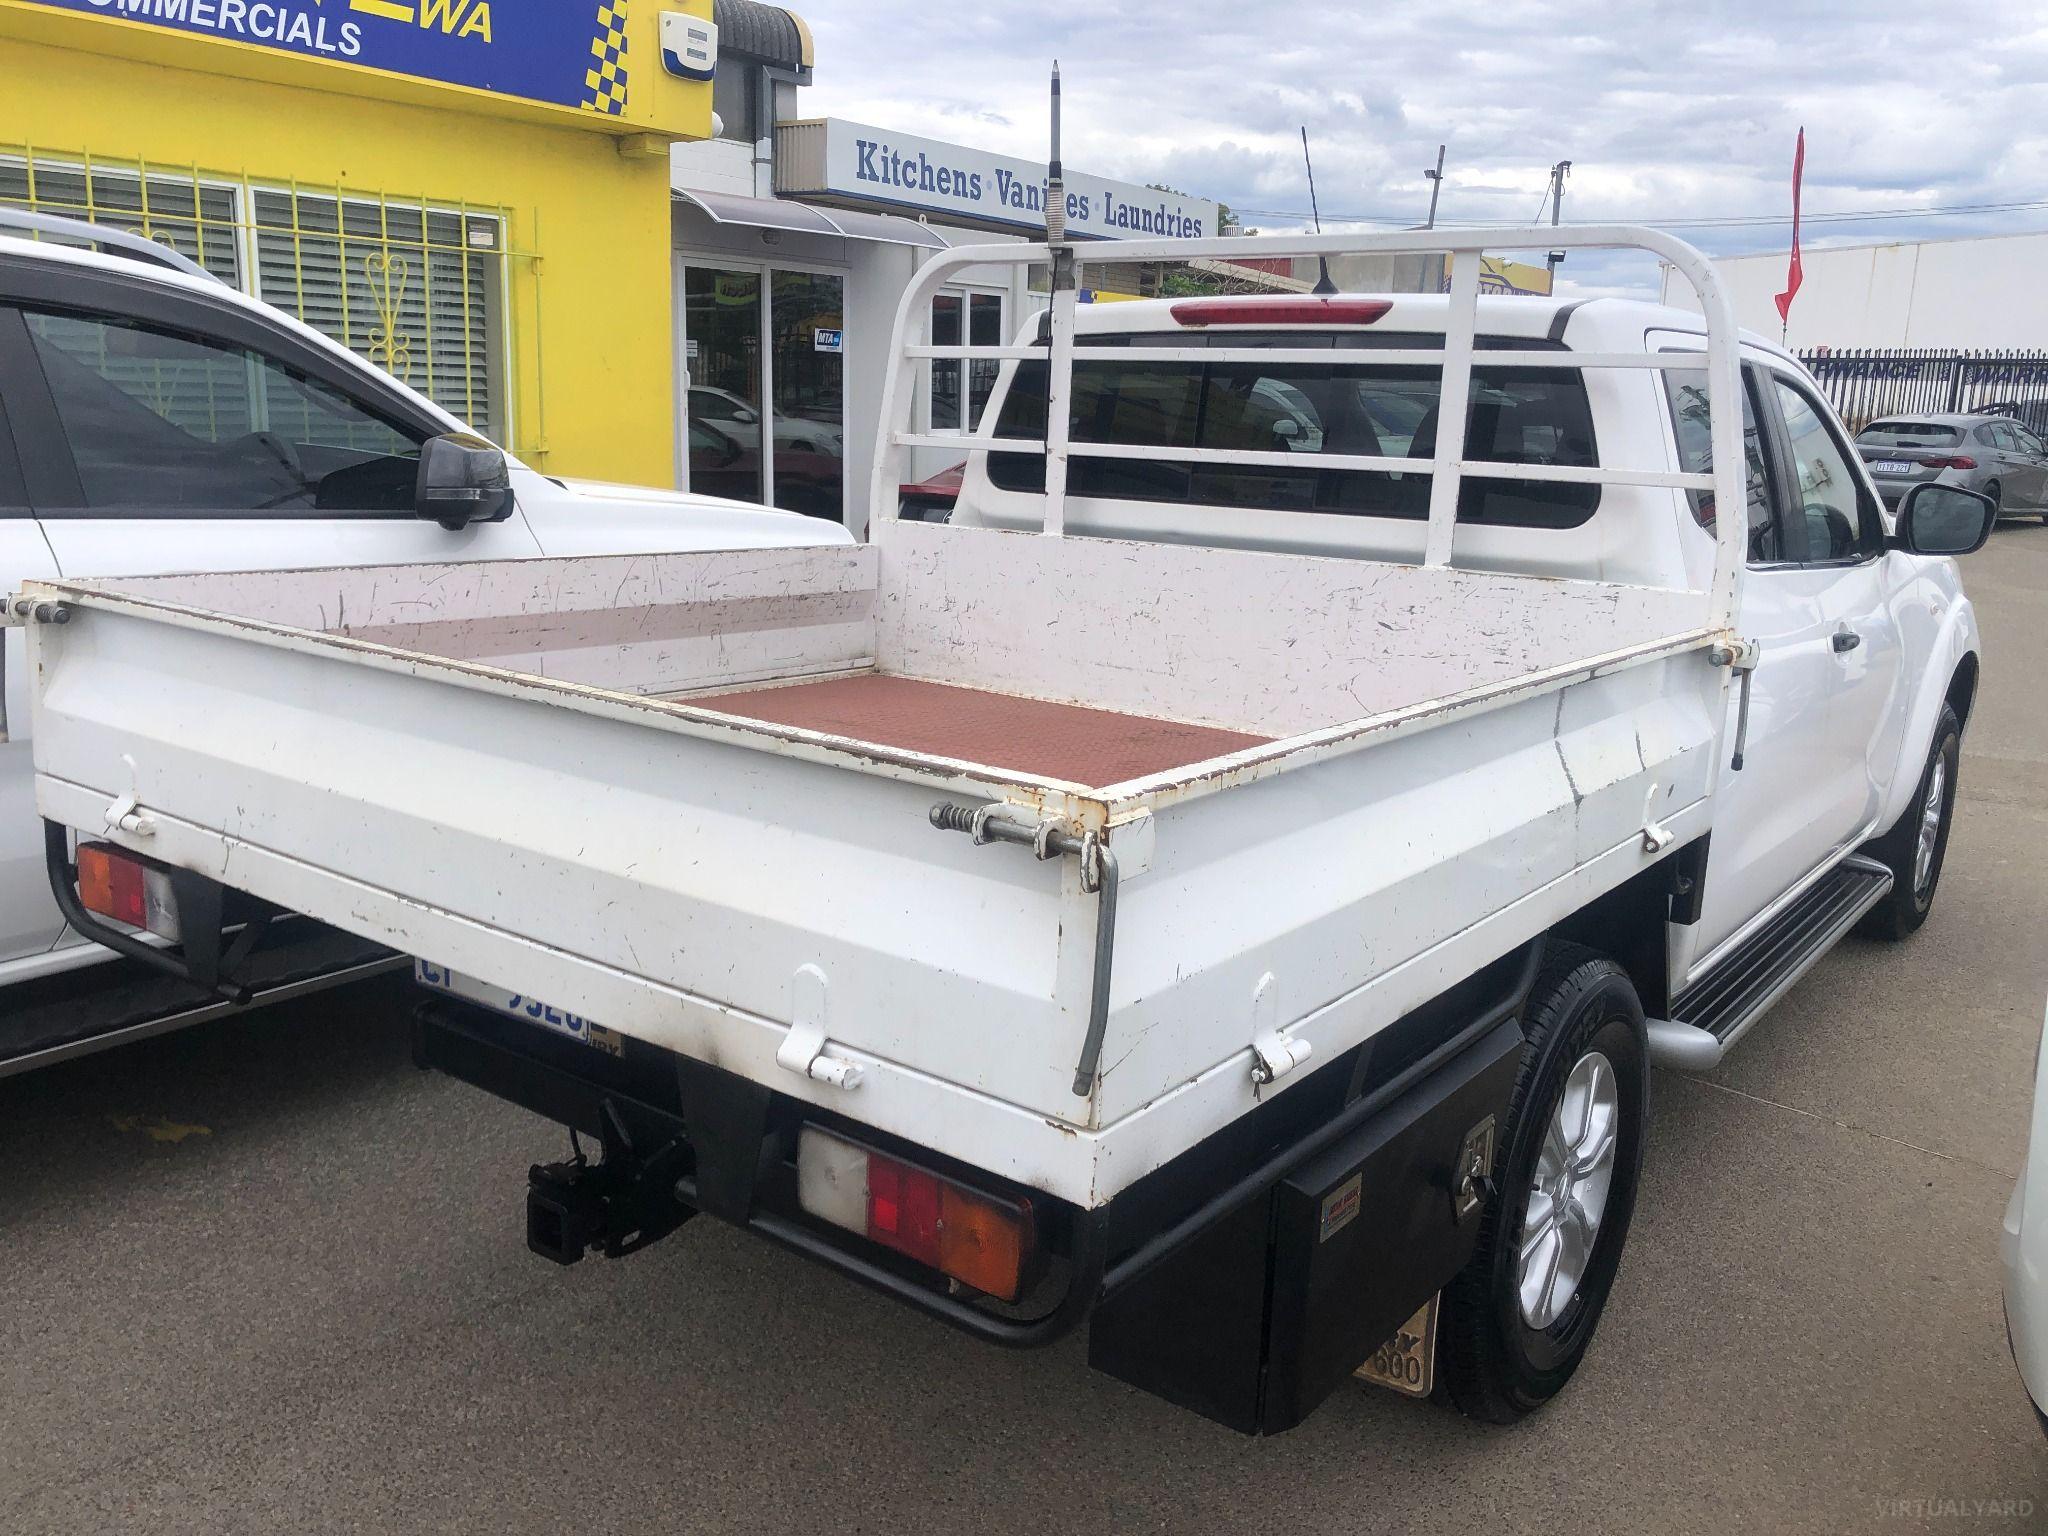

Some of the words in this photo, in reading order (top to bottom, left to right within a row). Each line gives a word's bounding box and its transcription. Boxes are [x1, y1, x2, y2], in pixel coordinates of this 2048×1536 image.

[856, 140, 982, 201] Kitchens
[995, 168, 1089, 220] Vanies
[1105, 192, 1202, 238] Laundries
[817, 332, 834, 344] MTA
